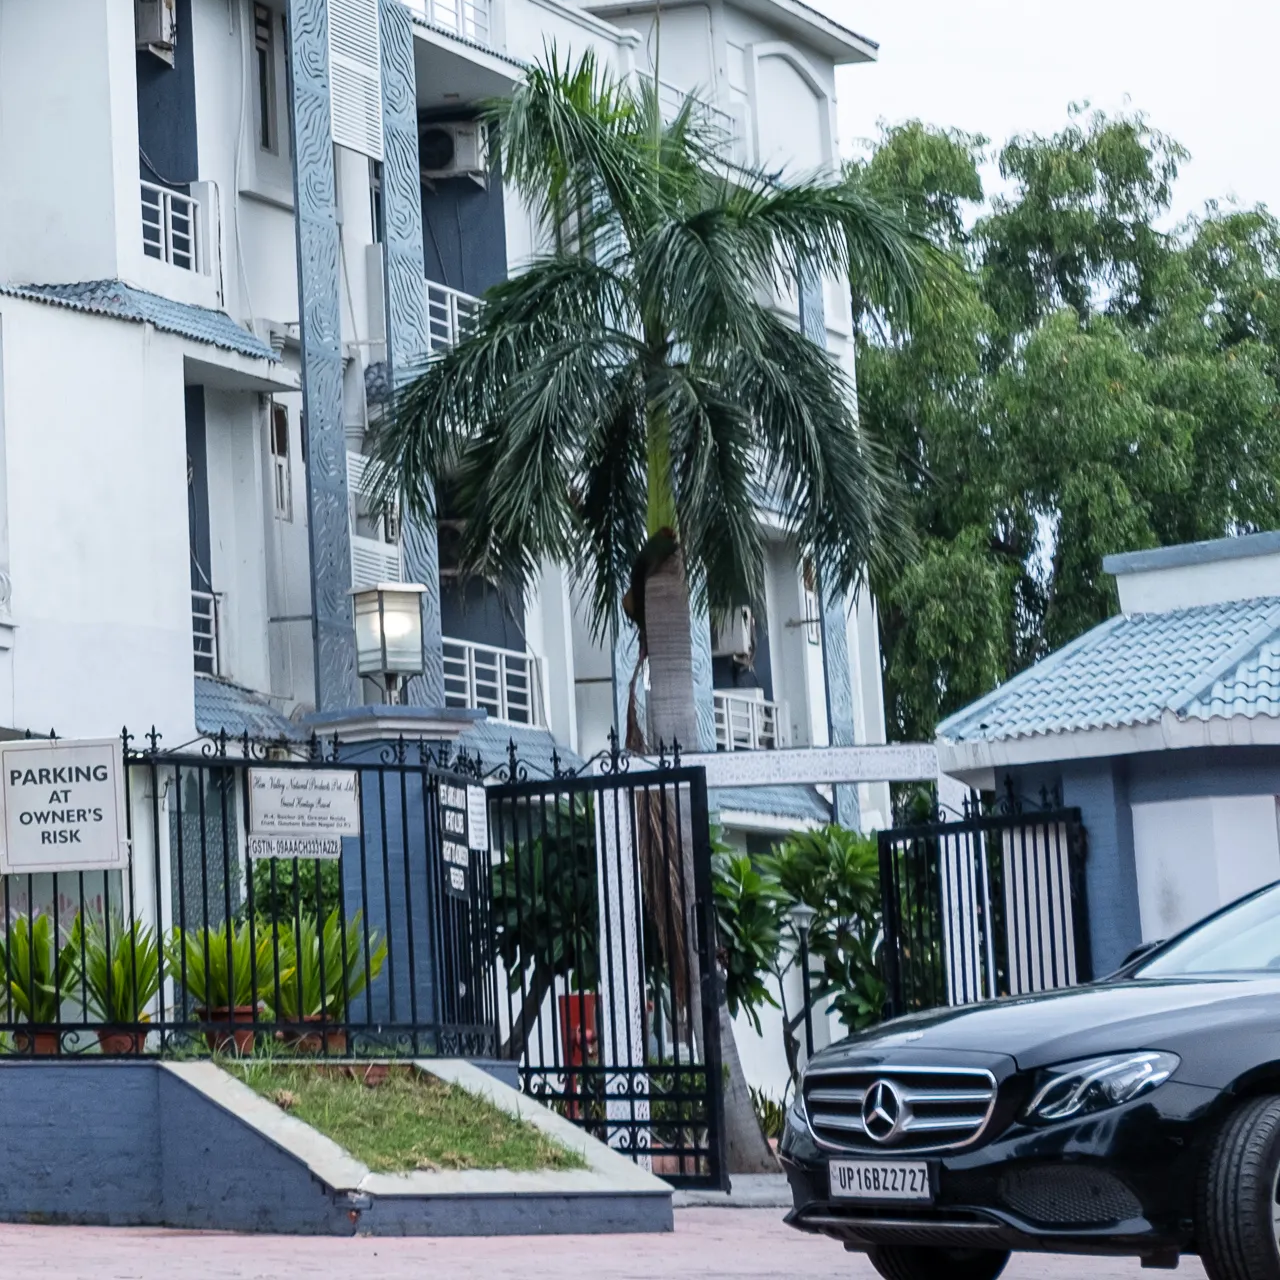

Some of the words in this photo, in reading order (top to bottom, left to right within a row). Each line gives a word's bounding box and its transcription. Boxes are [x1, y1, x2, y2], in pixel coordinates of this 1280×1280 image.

[10, 765, 108, 786] PARKING
[48, 789, 72, 804] AT
[19, 808, 103, 825] OWNER'S
[41, 829, 81, 844] RISK
[839, 1167, 927, 1192] UP16BZ2727
